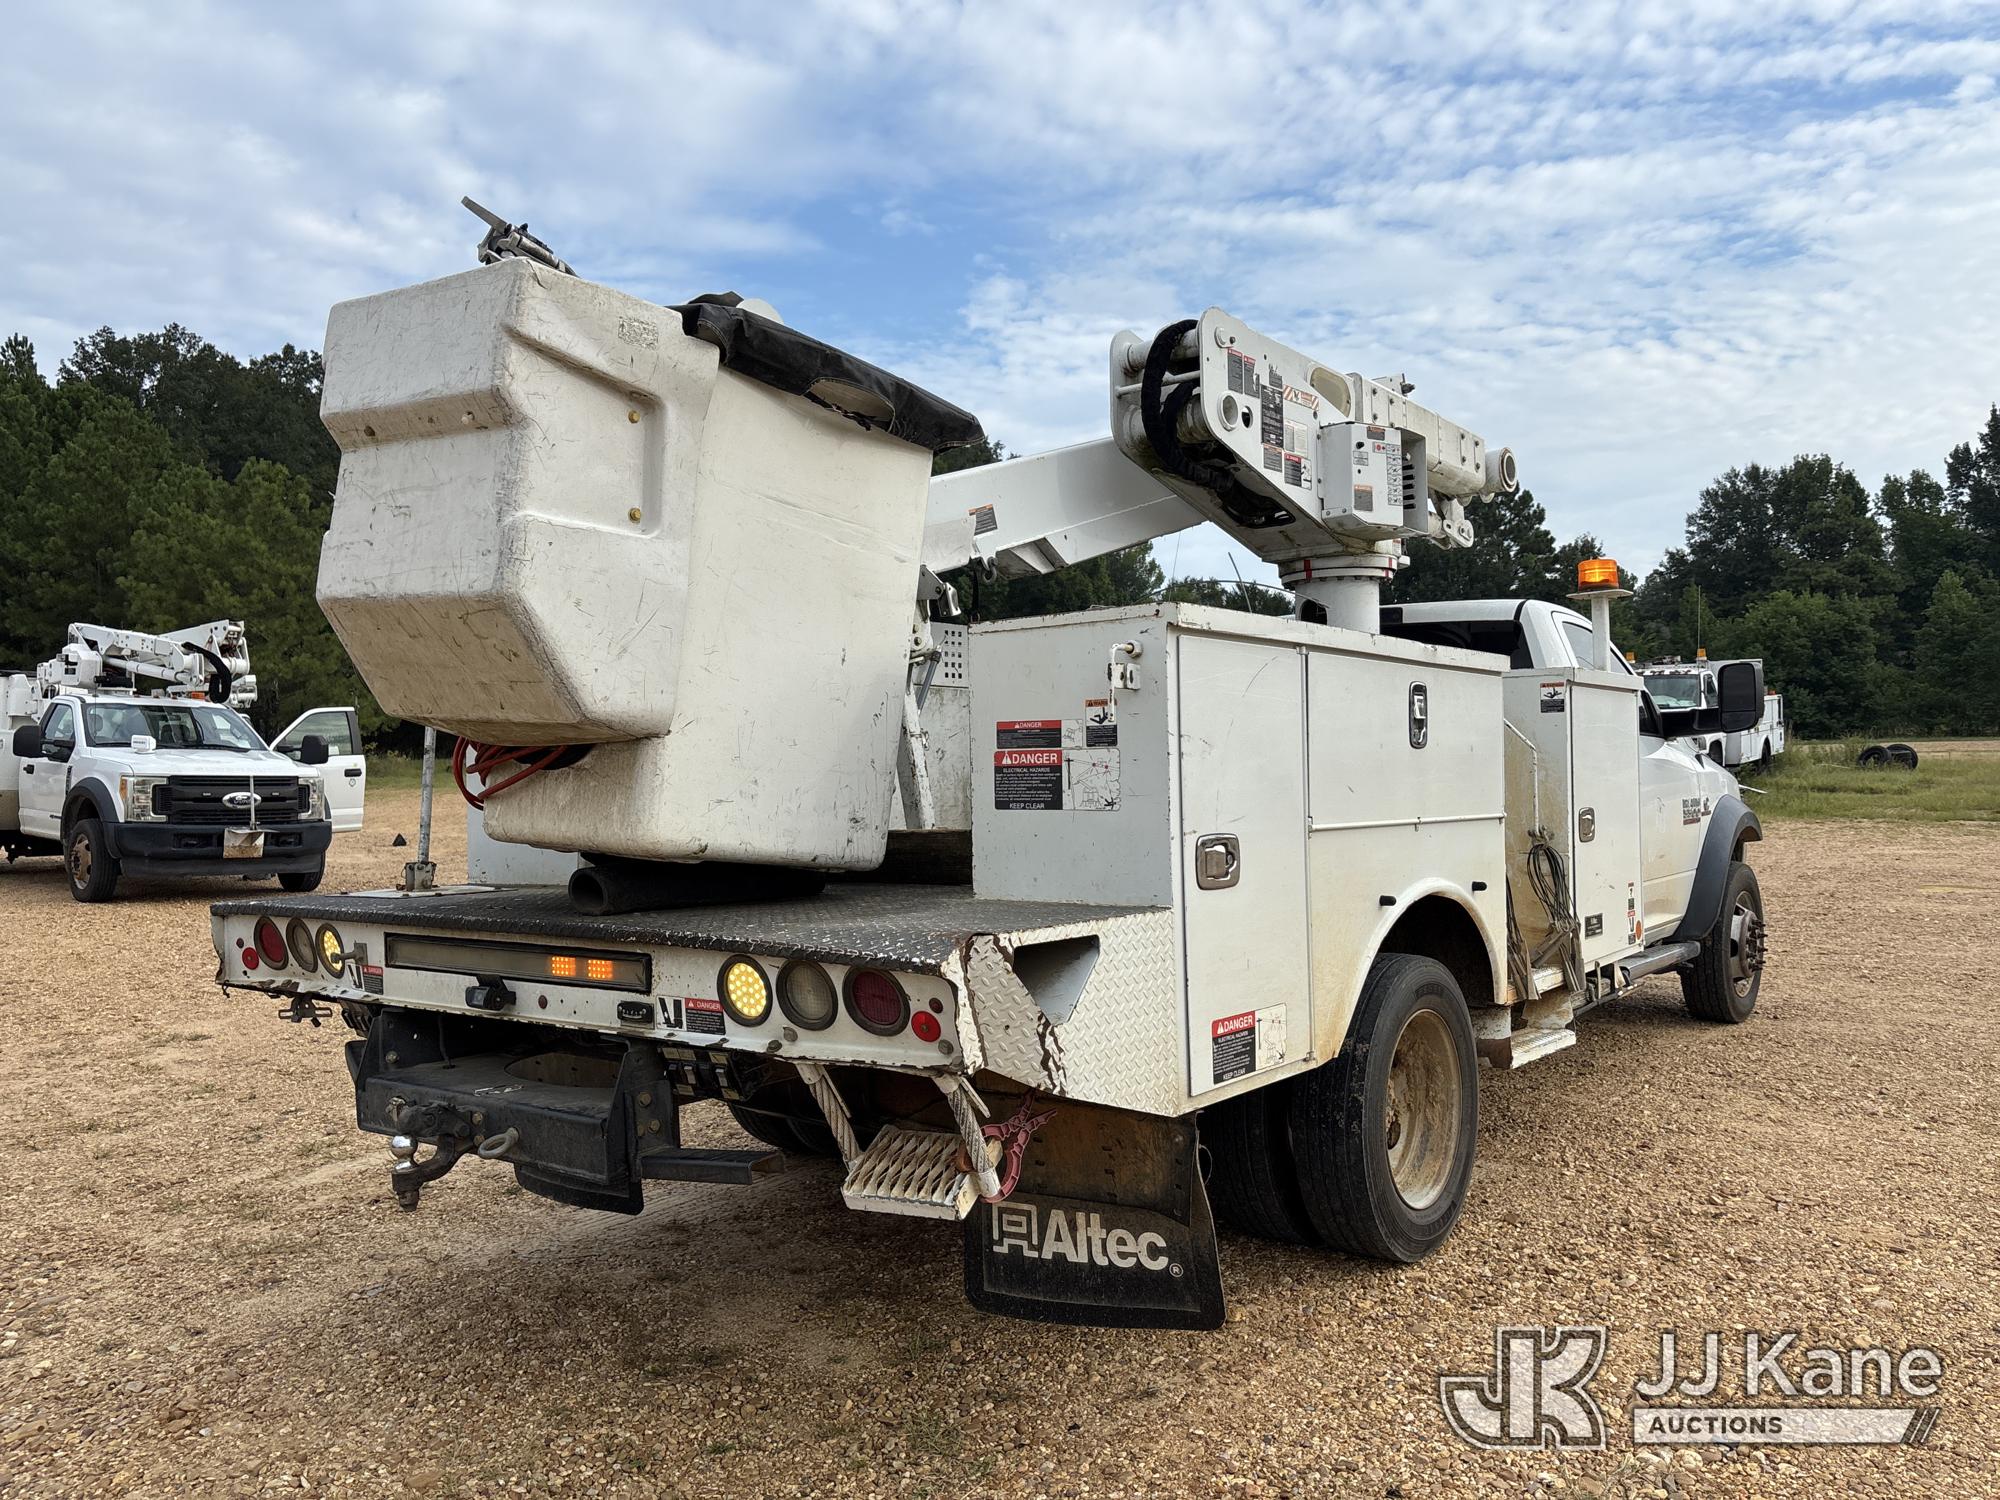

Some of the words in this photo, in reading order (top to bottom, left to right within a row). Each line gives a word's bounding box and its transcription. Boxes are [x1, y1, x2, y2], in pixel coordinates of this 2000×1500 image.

[1012, 753, 1058, 764] DANGER
[696, 1002, 721, 1010] DANGER
[1223, 1015, 1254, 1033] DANGER
[1040, 1208, 1170, 1271] Altec
